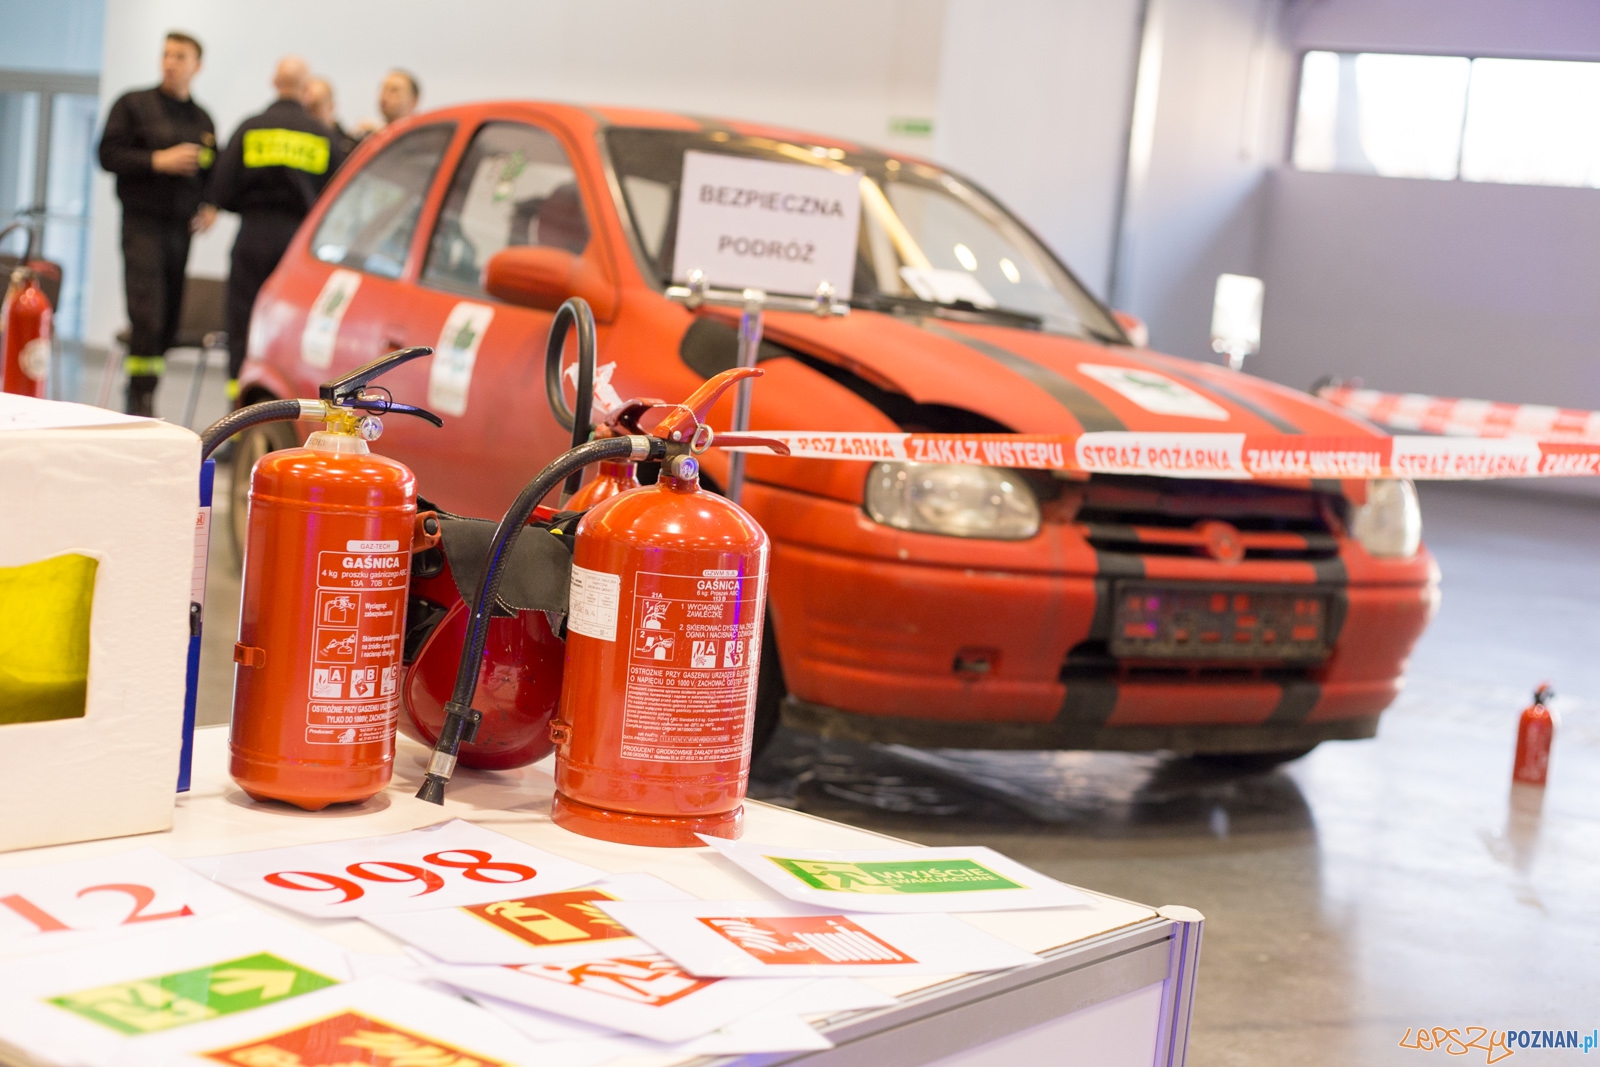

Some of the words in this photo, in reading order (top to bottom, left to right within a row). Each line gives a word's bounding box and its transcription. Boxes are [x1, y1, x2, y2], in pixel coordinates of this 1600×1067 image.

[700, 183, 844, 217] BEZPIECZNA
[718, 234, 815, 263] PODRÓŻ
[912, 438, 981, 464] ZAKAZ
[1082, 441, 1145, 468] STRAŻ
[1148, 442, 1236, 470] POŻARNA
[1247, 449, 1310, 475] ZAKAZ
[1454, 449, 1530, 476] POŻARNA
[1543, 453, 1600, 476] ZAKAZ
[342, 555, 400, 569] GAŚNICA
[328, 569, 338, 579] kg
[341, 570, 369, 579] proszku
[350, 579, 364, 587] 13A
[370, 579, 383, 587] 70B
[696, 578, 740, 591] GAŚNICA
[686, 623, 722, 632] SKIEROWAĆ
[640, 630, 646, 638] 2
[685, 630, 705, 639] OGNIA
[705, 641, 716, 655] A
[736, 640, 744, 653] B
[331, 669, 341, 681] A
[366, 668, 375, 681] B
[391, 666, 397, 676] C
[665, 670, 681, 678] PRZY
[683, 671, 710, 679] GASZENIU
[637, 676, 663, 686] NAPIĘCIU
[666, 678, 675, 686] DO
[677, 679, 689, 687] 1000
[311, 704, 343, 714] OSTROŻNIE
[343, 705, 358, 714] PRZY
[326, 715, 345, 724] TYLKO
[345, 715, 354, 724] DO
[263, 849, 537, 905] 998
[872, 867, 990, 879] WYJŚCIE
[884, 875, 998, 884] EWAKUACYJNE
